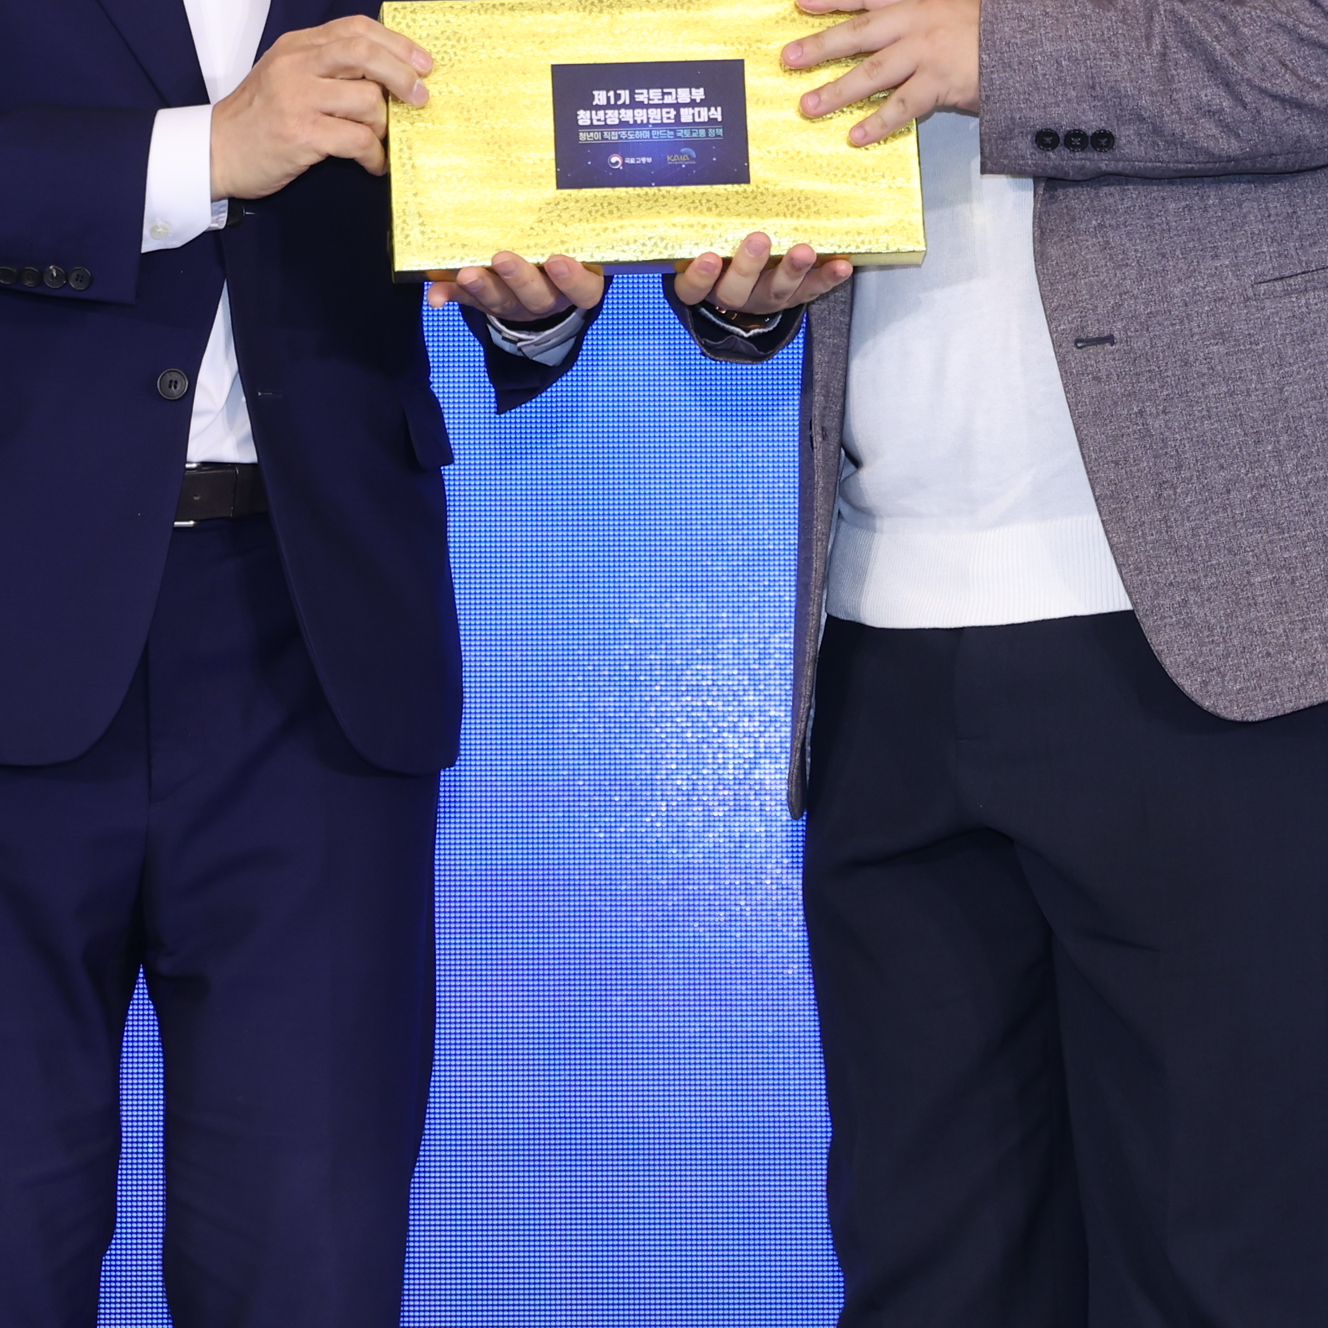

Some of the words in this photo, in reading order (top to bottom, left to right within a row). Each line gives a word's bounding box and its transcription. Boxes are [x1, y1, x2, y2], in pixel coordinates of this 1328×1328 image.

[592, 90, 630, 106] 제1기
[634, 87, 706, 104] 국토교통부
[576, 108, 676, 126] 청년정책위원단
[679, 106, 723, 122] 발대식
[578, 131, 602, 141] 청년이
[603, 131, 619, 140] 직접
[619, 130, 650, 140] 주도하며
[651, 129, 675, 139] 만드는
[675, 128, 707, 138] 국토교통
[708, 127, 723, 137] 정책
